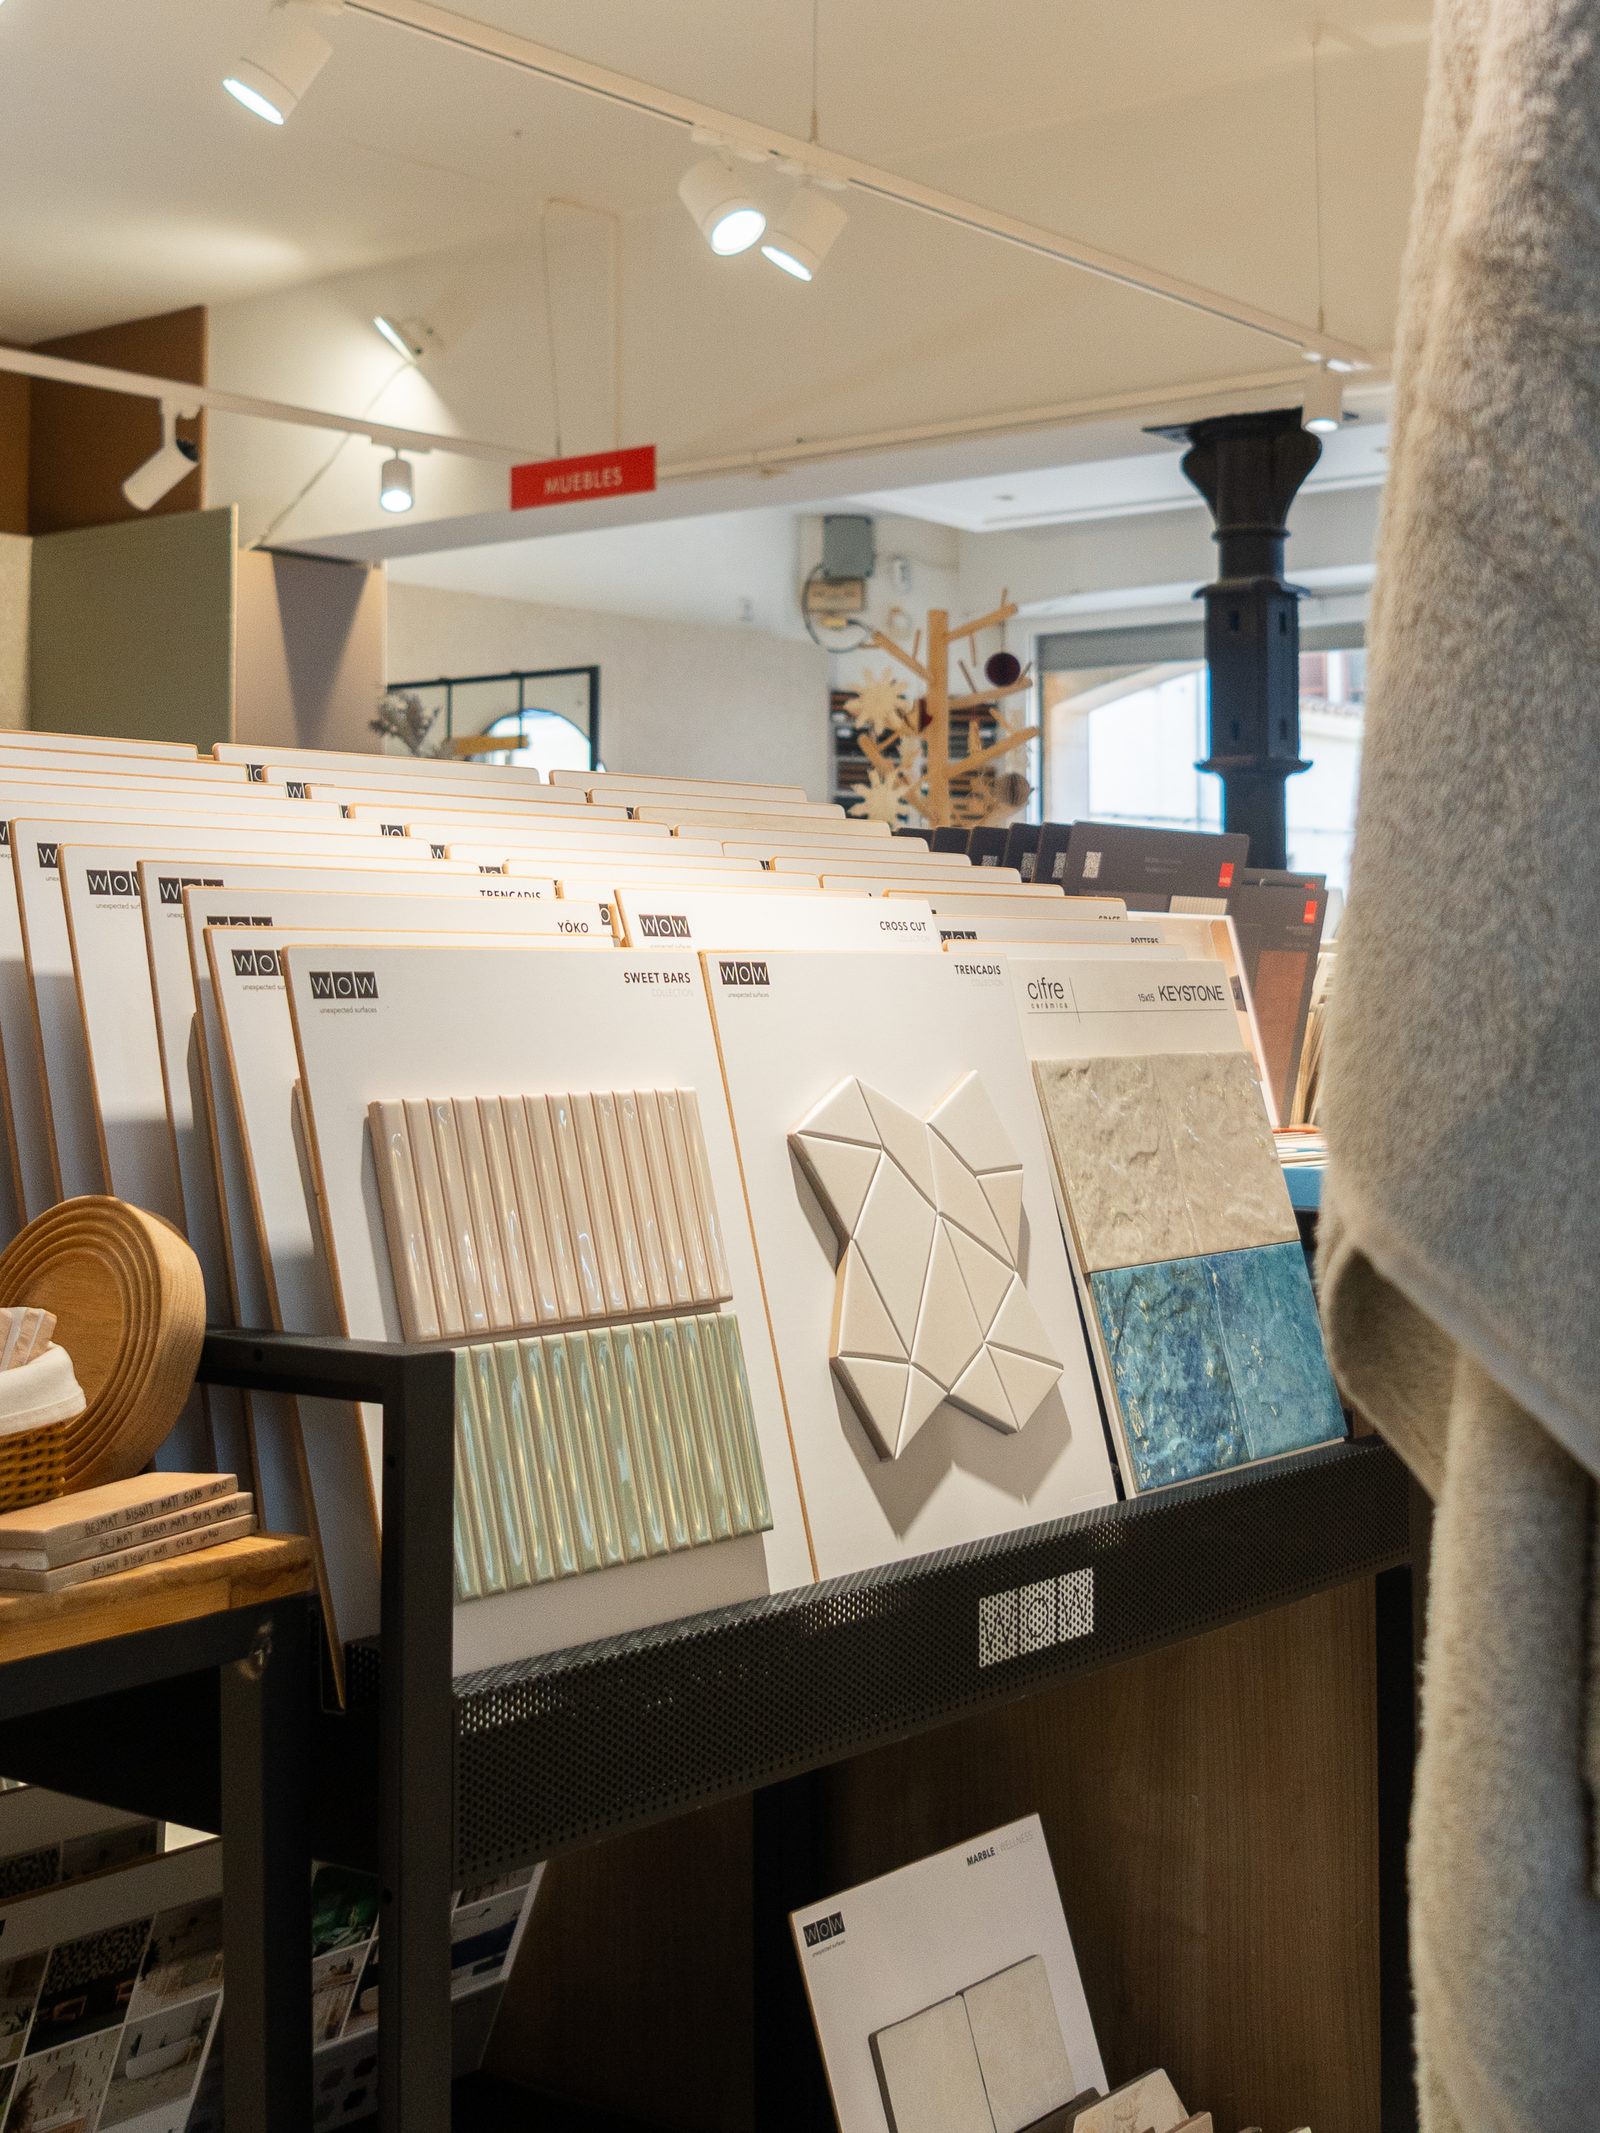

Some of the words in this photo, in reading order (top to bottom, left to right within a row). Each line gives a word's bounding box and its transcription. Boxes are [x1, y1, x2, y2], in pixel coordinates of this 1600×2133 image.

[544, 466, 623, 495] MUEBLES
[87, 874, 140, 892] WO
[640, 919, 689, 935] WOW
[880, 920, 908, 931] CROSS
[910, 921, 926, 931] CUT
[233, 953, 282, 973] WO
[954, 964, 1001, 976] TRENCADIS
[624, 972, 660, 984] SWEET
[663, 972, 691, 984] BARS
[720, 965, 768, 983] WOW
[310, 975, 376, 996] WOW
[1027, 976, 1065, 1000] cifre
[1137, 993, 1156, 1003] 15x15
[1157, 985, 1225, 1002] KEYSTONE
[320, 1006, 354, 1016] unexpected
[355, 1006, 378, 1014] surfaces
[981, 1580, 1091, 1653] WOW
[966, 1846, 995, 1866] MARBLE
[804, 1915, 844, 1944] WOW
